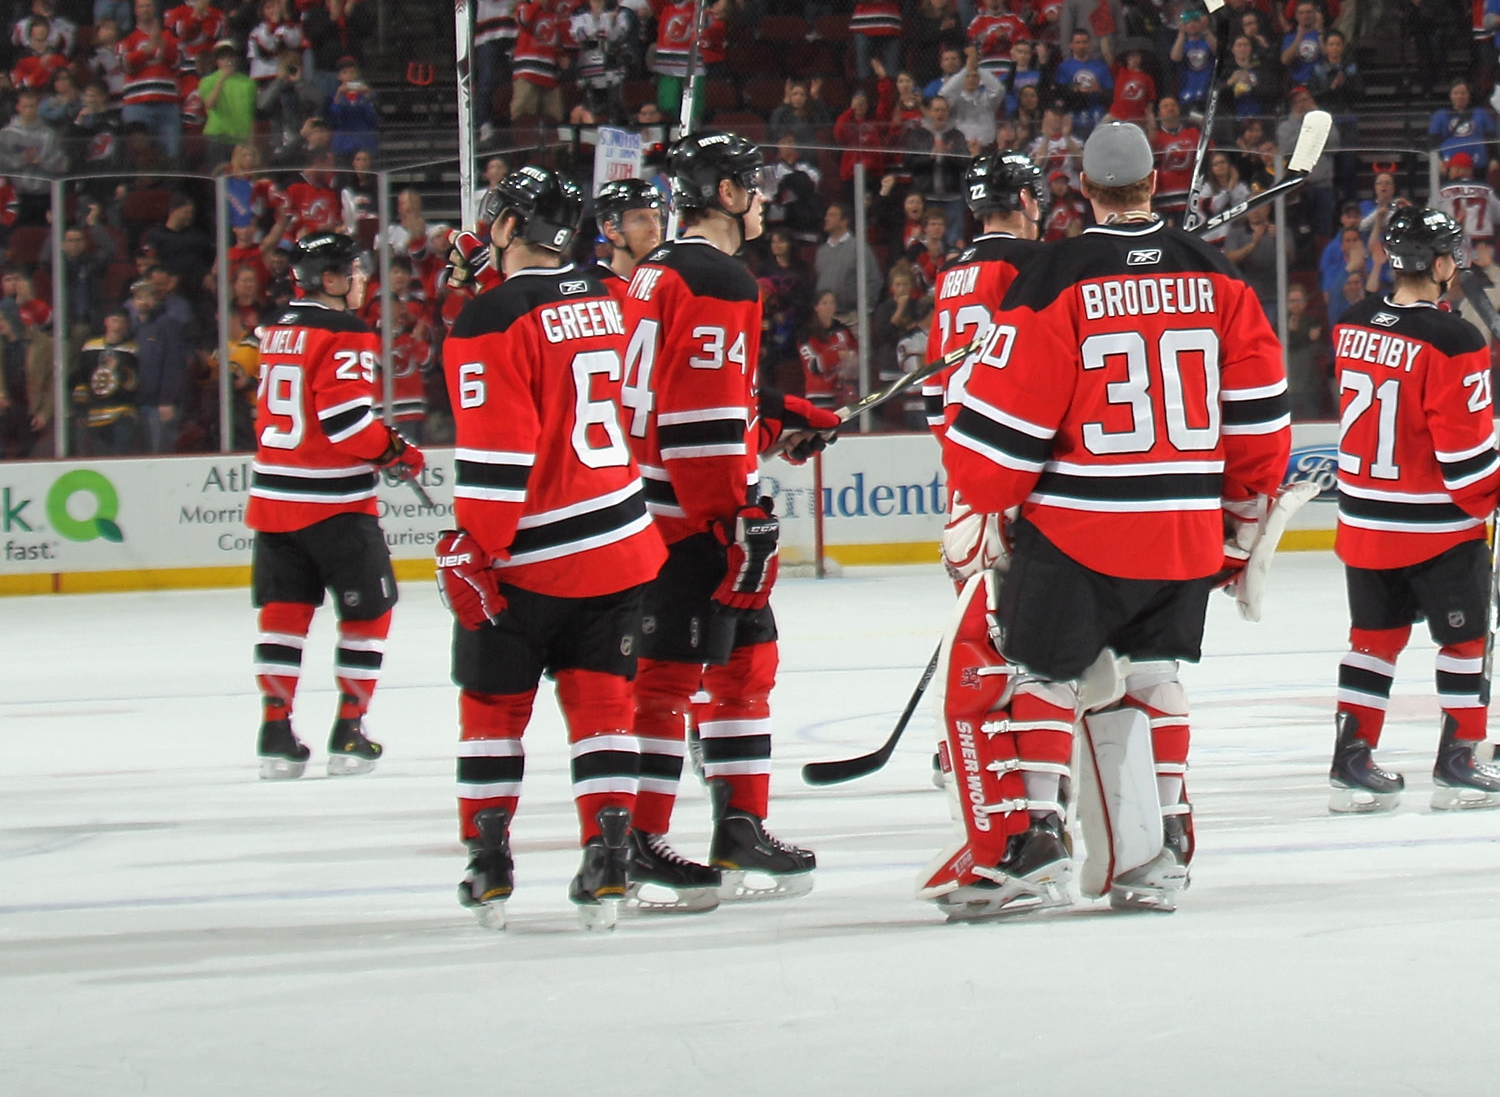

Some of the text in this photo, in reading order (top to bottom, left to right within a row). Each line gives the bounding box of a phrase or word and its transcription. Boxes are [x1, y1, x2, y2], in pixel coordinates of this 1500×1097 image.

[697, 134, 730, 148] DEVILS
[519, 166, 548, 182] DEVILS
[970, 184, 987, 200] 22
[553, 229, 568, 246] 6
[1207, 202, 1248, 230] S19
[1081, 277, 1216, 320] BRODEUR
[333, 350, 375, 384] 29
[689, 326, 747, 375] 34
[1336, 328, 1423, 373] TEDENBY
[459, 362, 485, 409] 6
[1080, 330, 1221, 456] 30
[1463, 369, 1493, 413] 21
[571, 349, 630, 469] 6
[1337, 369, 1401, 481] 21
[757, 472, 947, 519] Prudent
[750, 524, 778, 533] CCM
[4, 540, 57, 561] fast.
[436, 553, 471, 568] UER
[955, 720, 992, 832] SHER-WOOD
